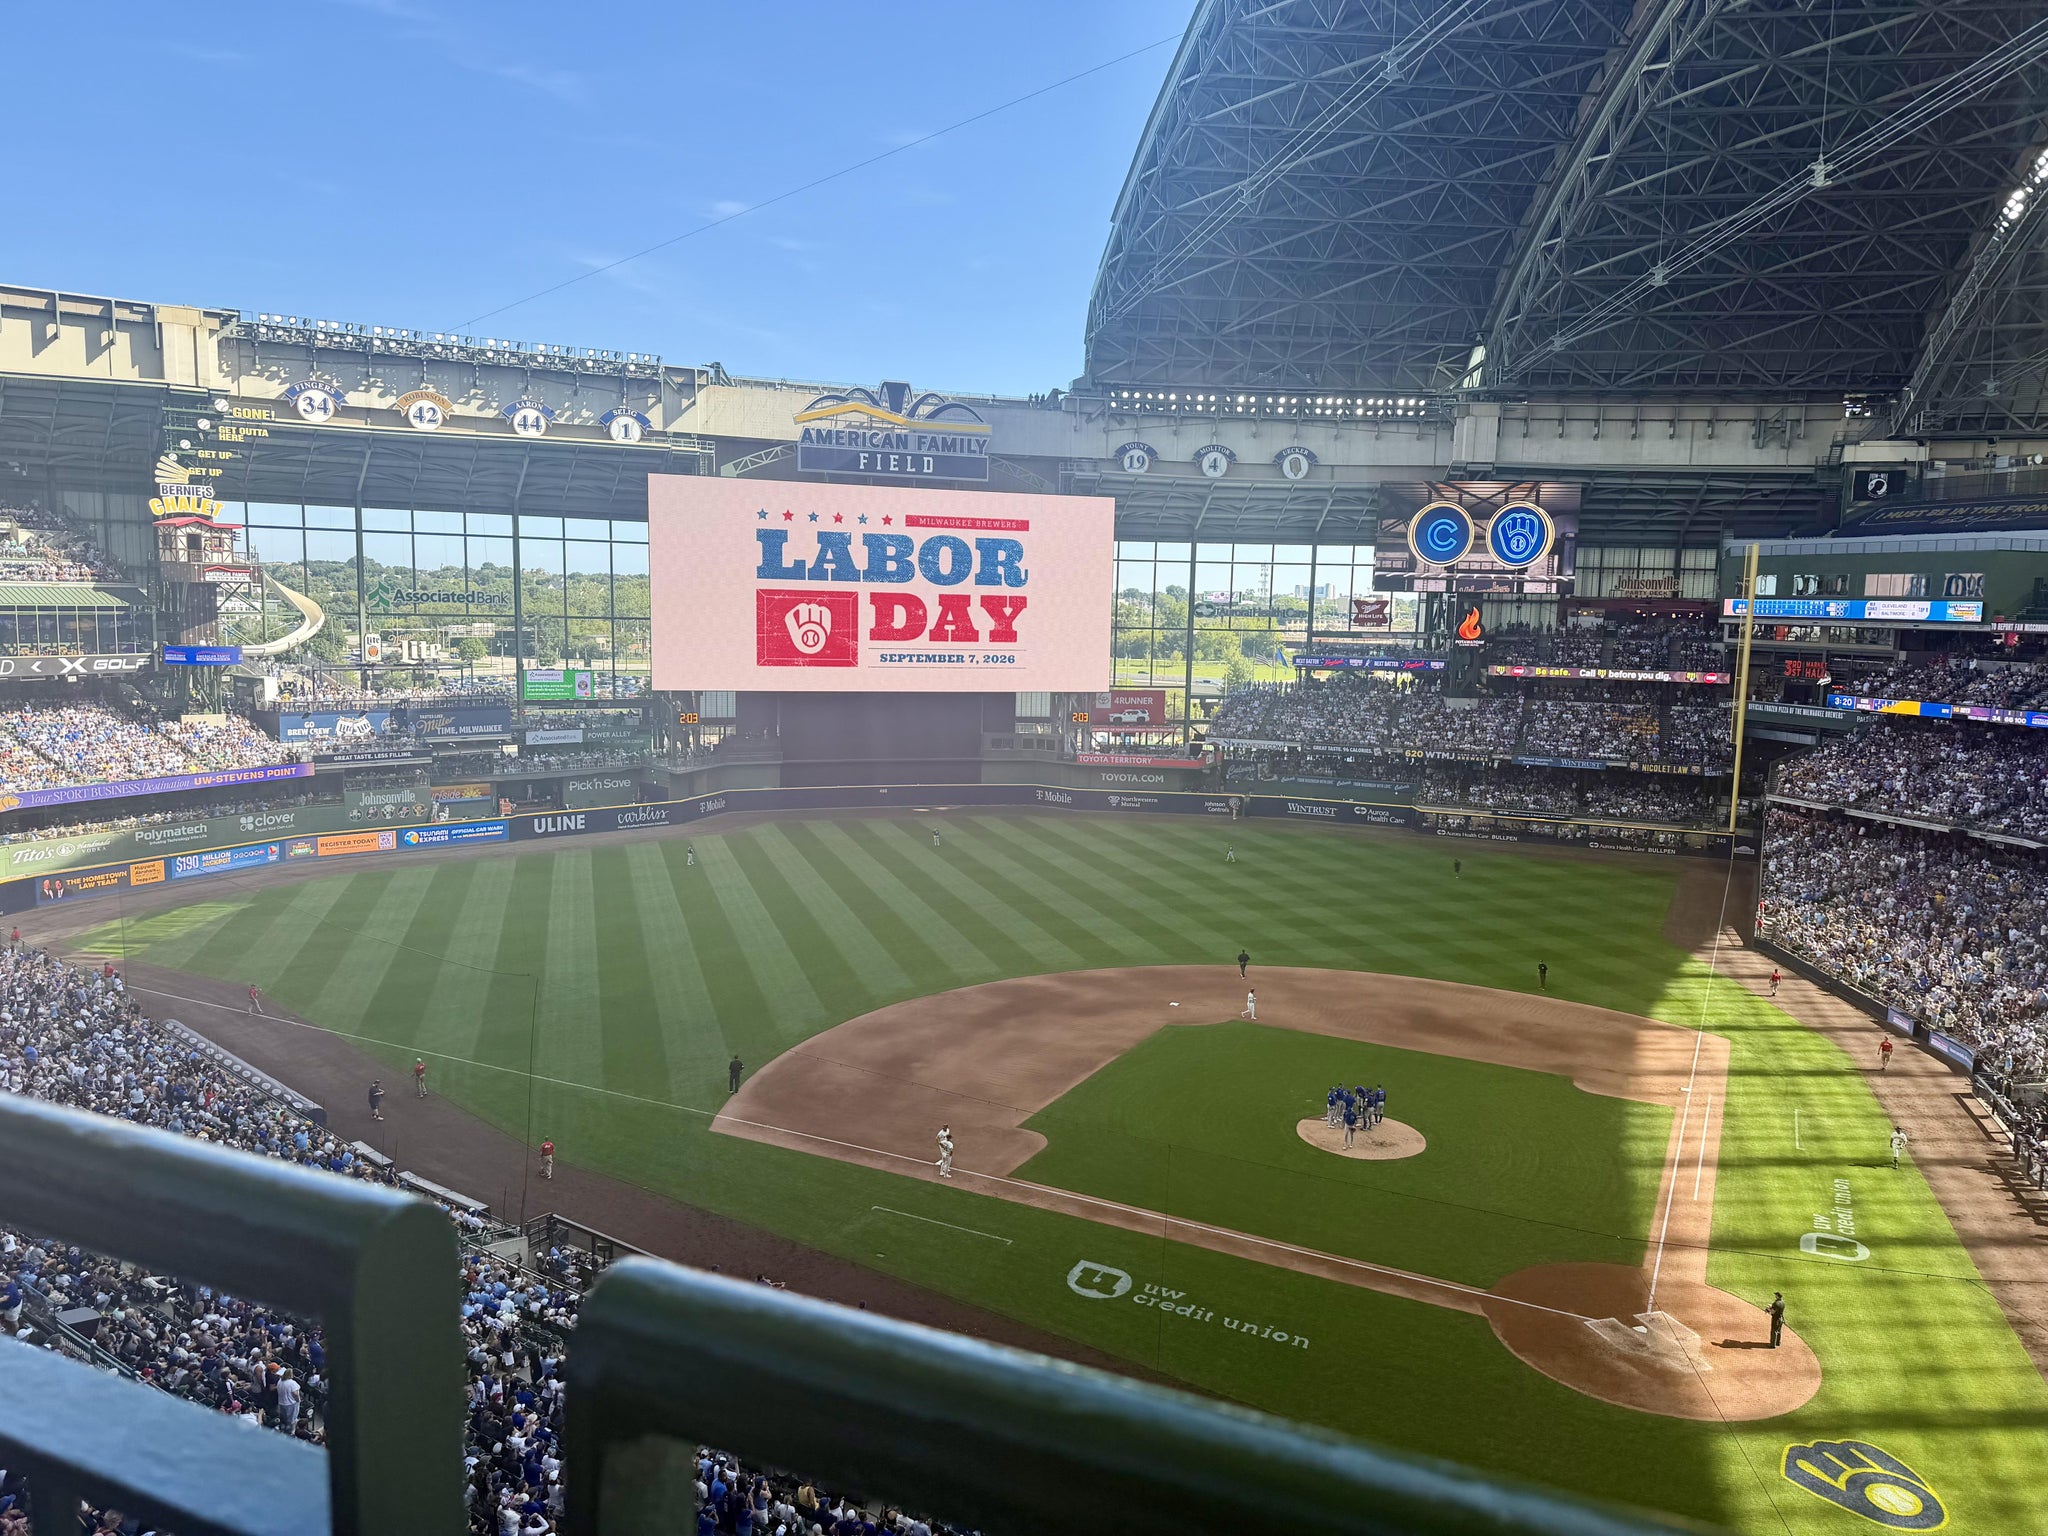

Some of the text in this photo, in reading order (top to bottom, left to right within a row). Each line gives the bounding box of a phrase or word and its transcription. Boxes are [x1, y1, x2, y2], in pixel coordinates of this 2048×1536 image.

[295, 381, 336, 394] FINGERS
[405, 391, 446, 404] ROBINSON
[303, 397, 330, 415] 34
[515, 402, 543, 411] AARON
[613, 408, 637, 417] SELIG
[232, 407, 275, 420] GONE!
[413, 406, 439, 424] 42
[517, 414, 542, 432] 44
[218, 426, 269, 437] GET OUTTA
[219, 433, 244, 442] HERE
[621, 424, 631, 439] 1
[800, 427, 988, 455] AMERICAN FAMILY
[198, 450, 233, 459] GET UP
[859, 453, 934, 473] FIELD
[1127, 455, 1145, 470] 19
[1208, 458, 1219, 472] 4
[188, 467, 222, 476] GET UP
[161, 485, 214, 497] BERNIE'S
[149, 496, 224, 518] CHALET
[1887, 510, 1927, 519] MUST
[1950, 507, 1969, 515] IN
[1971, 506, 1999, 514] THE
[919, 518, 1017, 528] MILWAUKEE BREWERS
[756, 528, 1029, 588] LABOR
[1614, 576, 1680, 590] Johnsonville
[869, 592, 1028, 643] DAY
[1998, 623, 2013, 631] REPORT
[879, 653, 1016, 666] SEPTEMBER 7, 2026
[1579, 669, 1596, 677] Call
[1608, 670, 1637, 678] before
[1655, 672, 1671, 681] dig.
[1114, 697, 1153, 705] 4RUNNER
[1834, 697, 1852, 706] 3:20
[288, 728, 308, 736] BREW
[437, 724, 503, 735] TIME, MILWAUKEE
[1426, 751, 1455, 760] WTMJ
[1561, 758, 1602, 768] WINTRUST
[1642, 764, 1688, 774] NICOLET LAW
[194, 767, 297, 785] UW-STEVENS POINT
[1101, 773, 1164, 783] TOYOTA.COM
[30, 778, 190, 804] Your SPORT BUSINESS Destination
[569, 781, 592, 791] Pick
[604, 778, 631, 788] Save
[359, 789, 416, 806] Johnsonville
[1045, 792, 1072, 804] Mobile
[706, 798, 726, 811] Mobile
[1288, 803, 1337, 815] WINTRUST
[255, 812, 294, 827] clover
[617, 806, 669, 824] carbliss
[1368, 809, 1389, 817] Aurora
[534, 815, 586, 834] ULINE
[135, 824, 207, 841] Polymatech
[13, 848, 55, 864] Tito's
[202, 852, 231, 861] MILLION
[203, 857, 231, 867] JACKPOT
[176, 855, 199, 873] $190
[66, 871, 128, 886] THE HOMETOWN
[79, 878, 118, 890] LAW TEAM
[1144, 1282, 1186, 1300] uw
[1133, 1293, 1310, 1349] credit union
